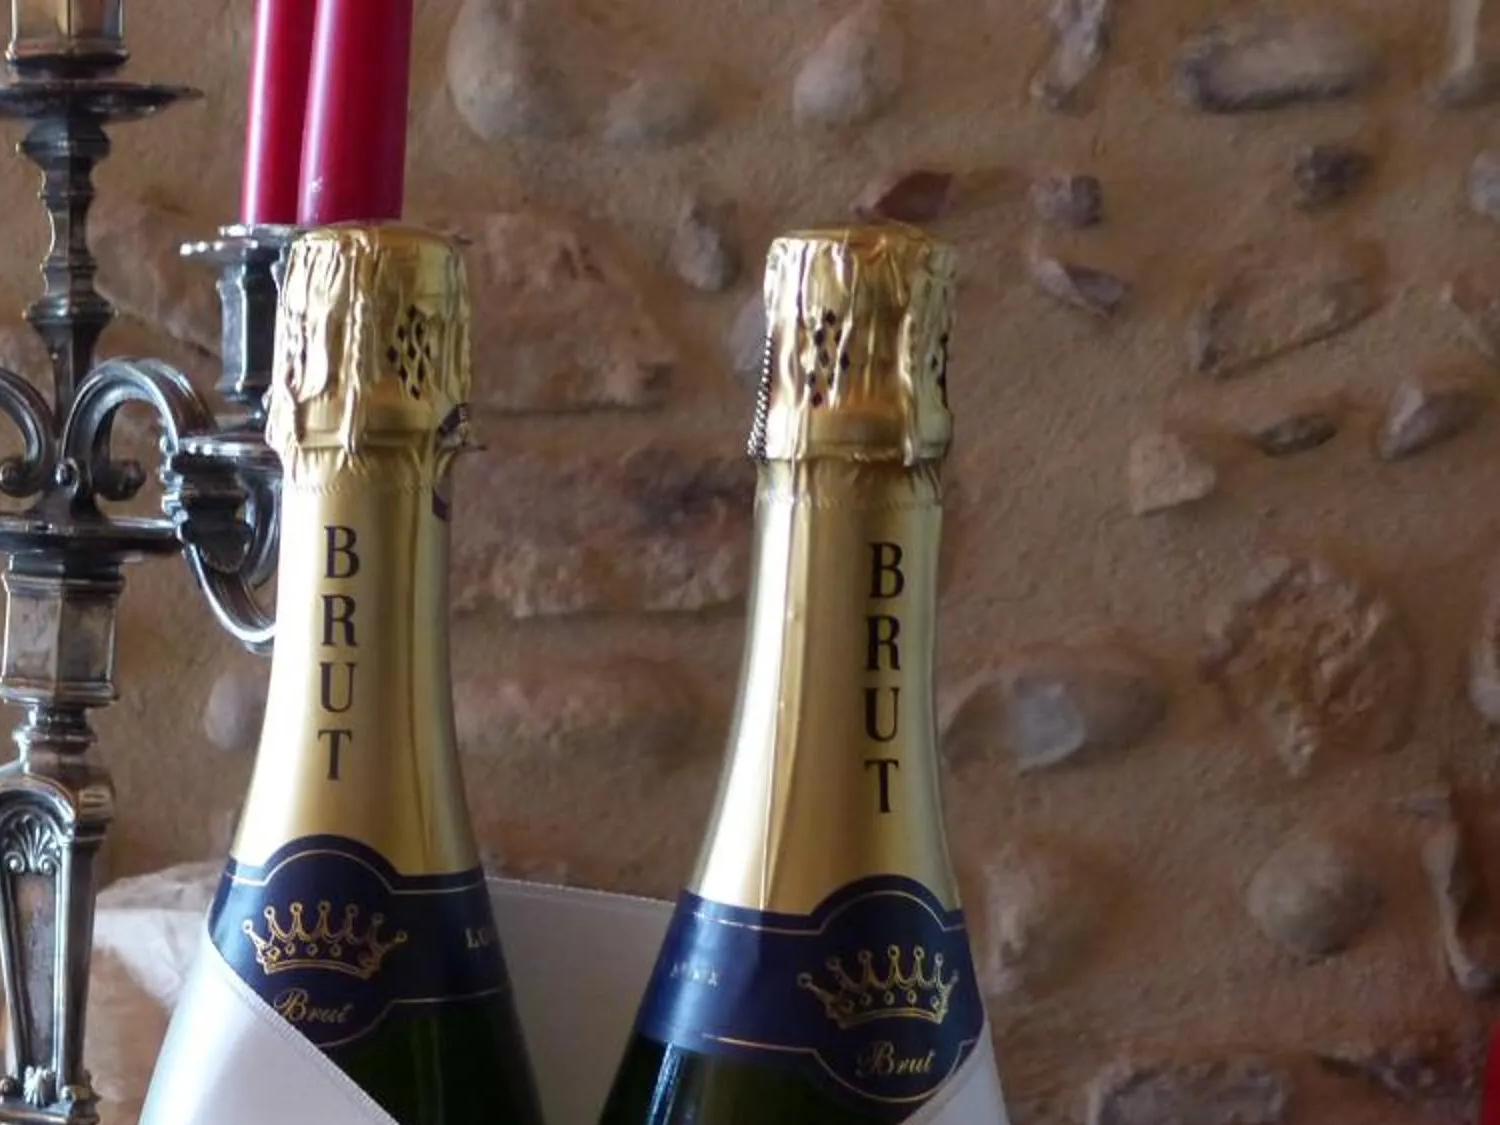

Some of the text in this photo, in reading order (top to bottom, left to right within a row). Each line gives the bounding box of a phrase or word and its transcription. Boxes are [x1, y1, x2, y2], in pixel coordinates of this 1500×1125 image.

[318, 525, 360, 781] BRUT
[864, 542, 904, 814] BRUT
[273, 987, 354, 1024] Brut
[856, 1040, 936, 1076] Brut
